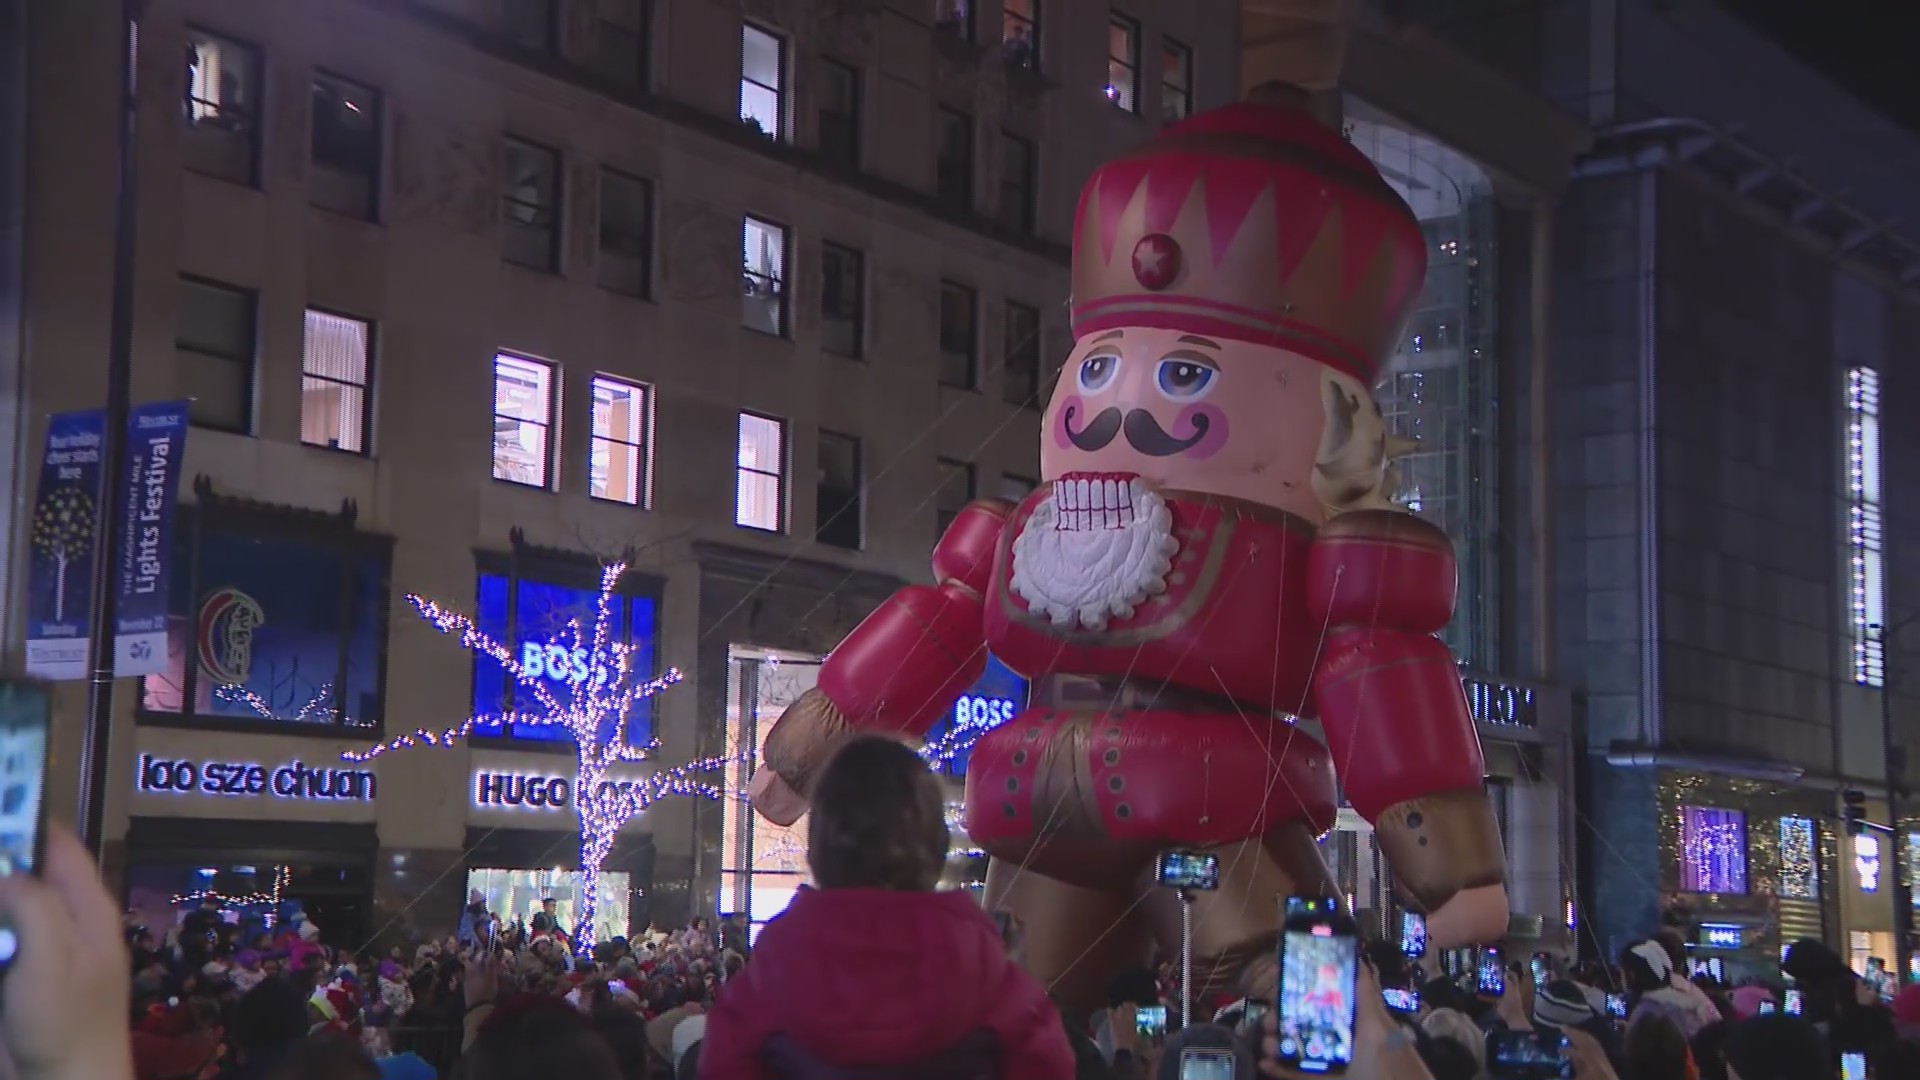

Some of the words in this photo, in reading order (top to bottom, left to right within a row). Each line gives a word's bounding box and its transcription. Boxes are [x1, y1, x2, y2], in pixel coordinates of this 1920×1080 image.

[135, 526, 161, 594] Lights
[956, 696, 1014, 728] BOSS
[138, 753, 198, 793] lao
[201, 761, 268, 795] sze
[270, 760, 377, 800] chuan
[475, 770, 571, 808] HUGO
